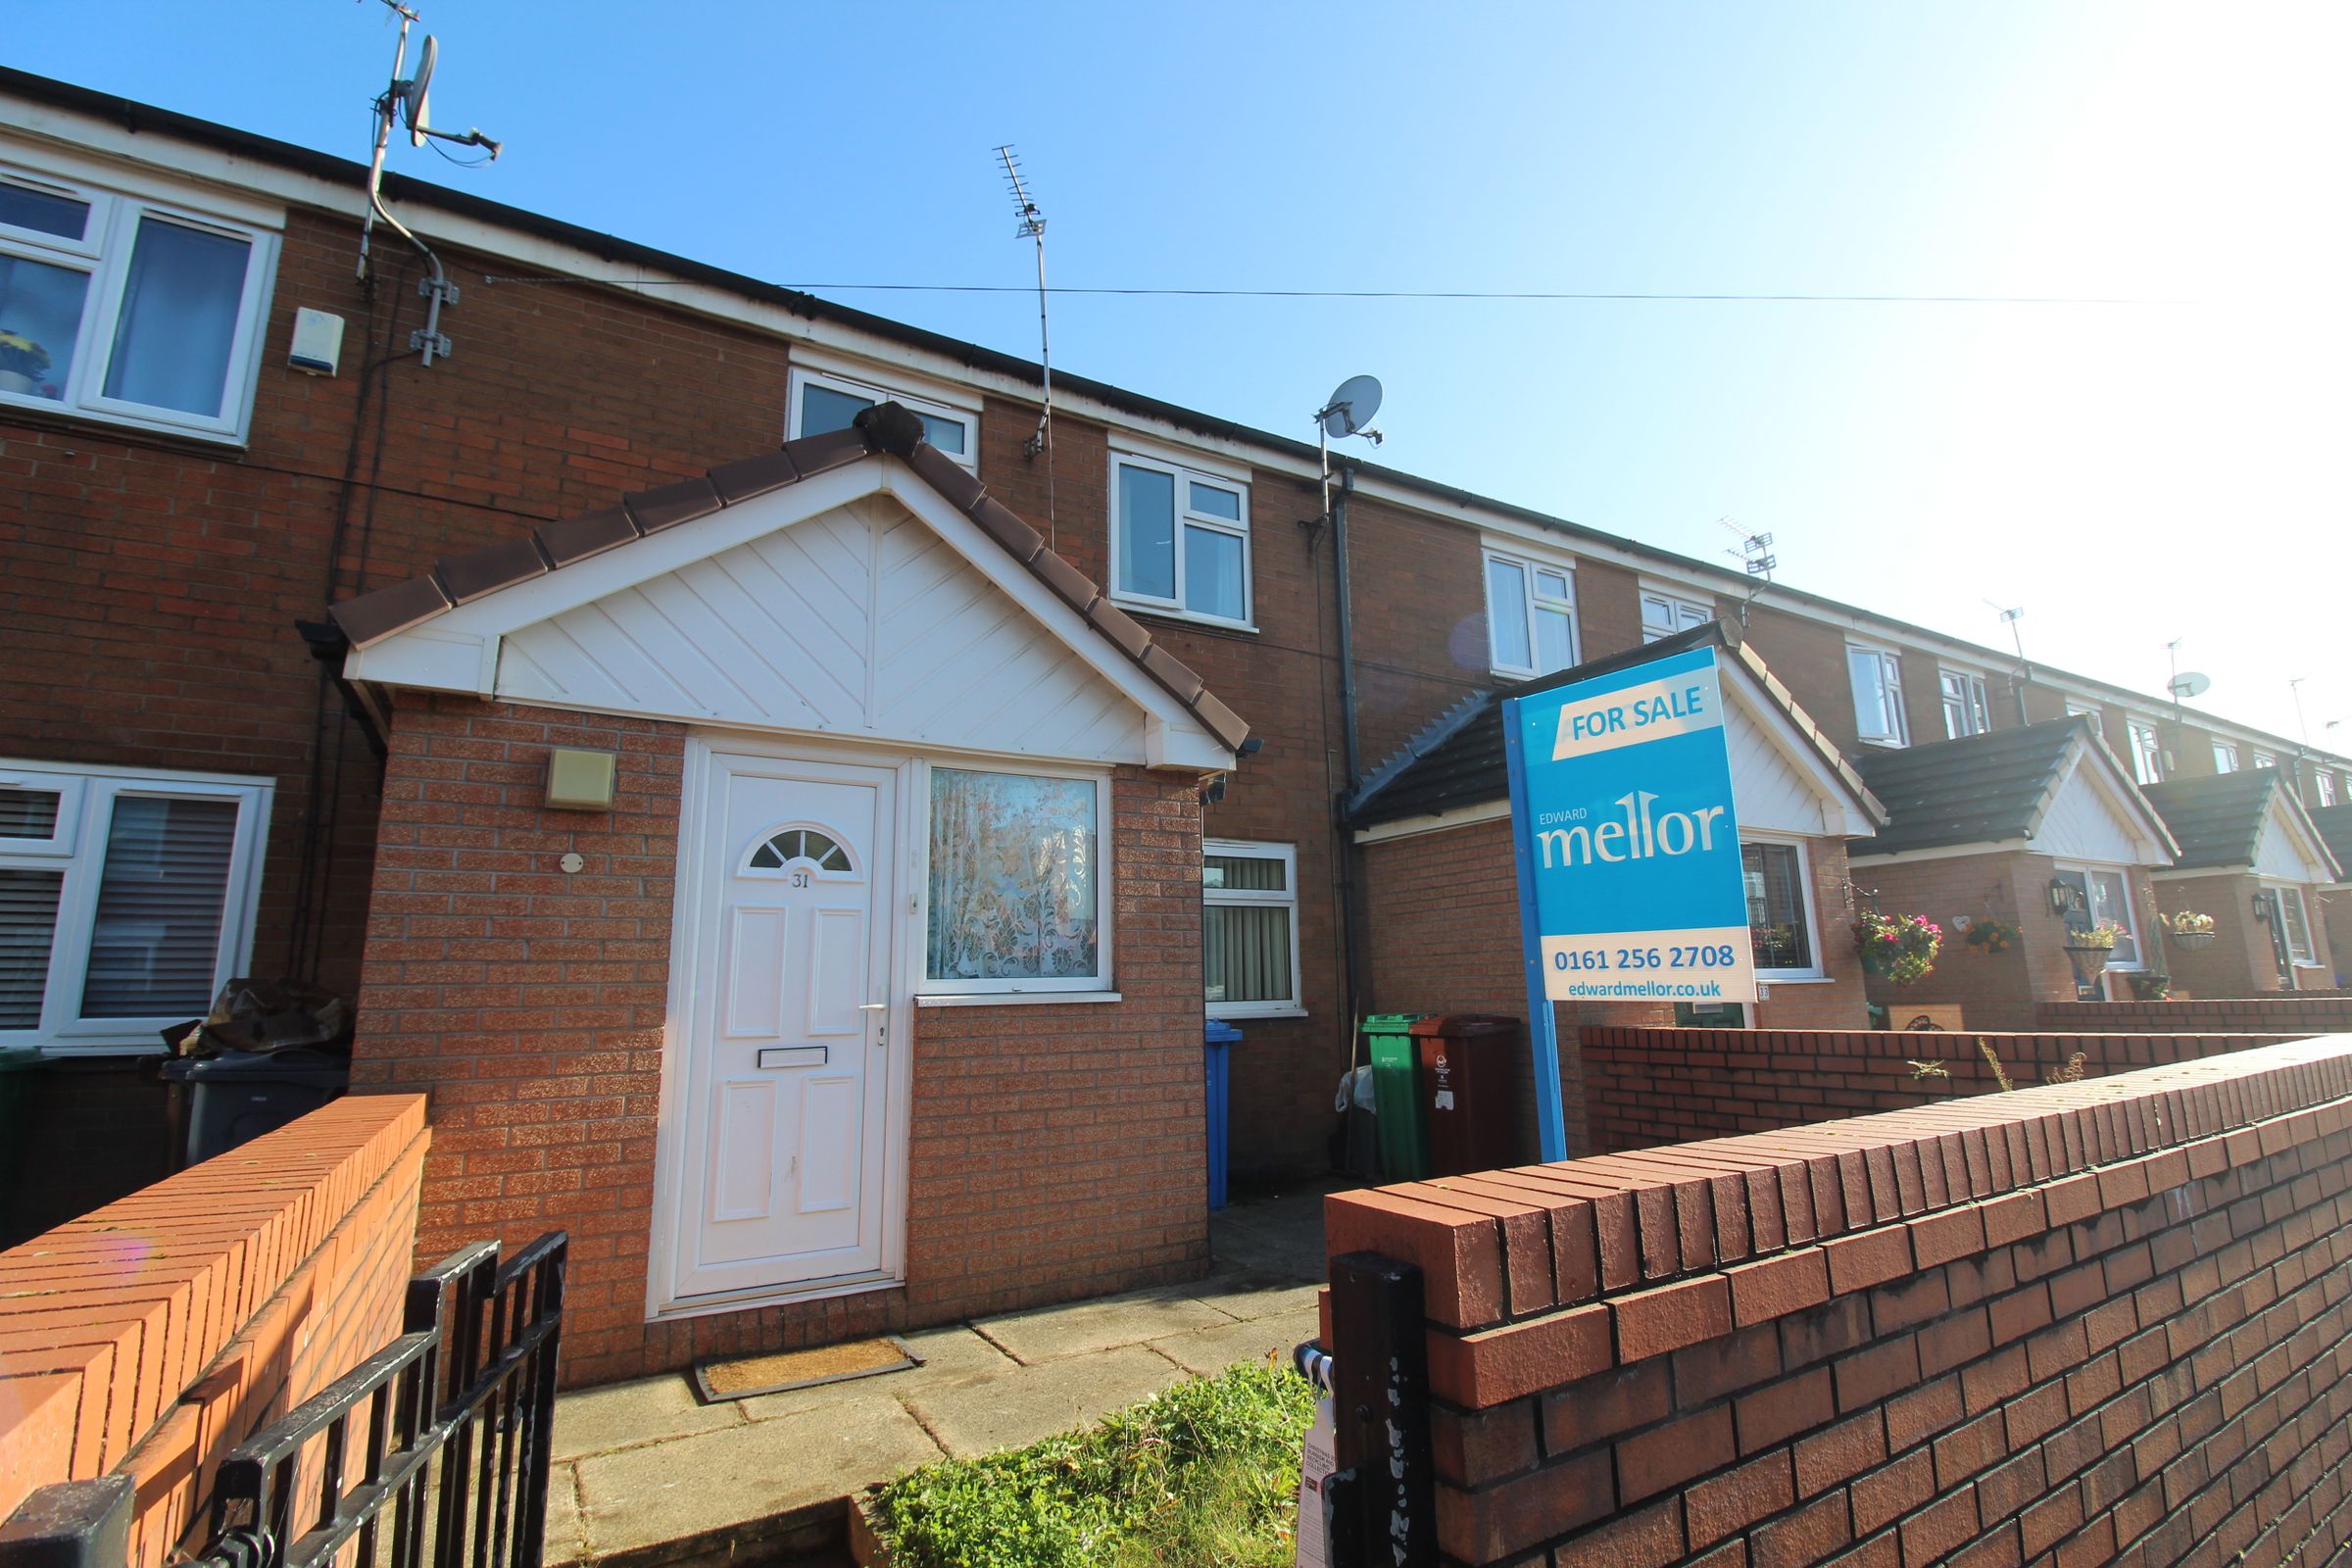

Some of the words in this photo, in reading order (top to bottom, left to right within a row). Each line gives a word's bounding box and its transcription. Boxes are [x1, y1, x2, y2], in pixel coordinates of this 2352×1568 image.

[1572, 707, 1626, 741] FOR
[1633, 686, 1703, 726] SALE
[1540, 808, 1588, 825] EDWARD
[1537, 790, 1725, 868] mellor
[792, 874, 808, 889] 31
[1554, 951, 1609, 970] 0161
[1617, 948, 1661, 969] 256
[1669, 945, 1735, 967] 2708
[1568, 980, 1722, 997] edwardmellor.co.uk
[1759, 987, 1769, 998] 33
